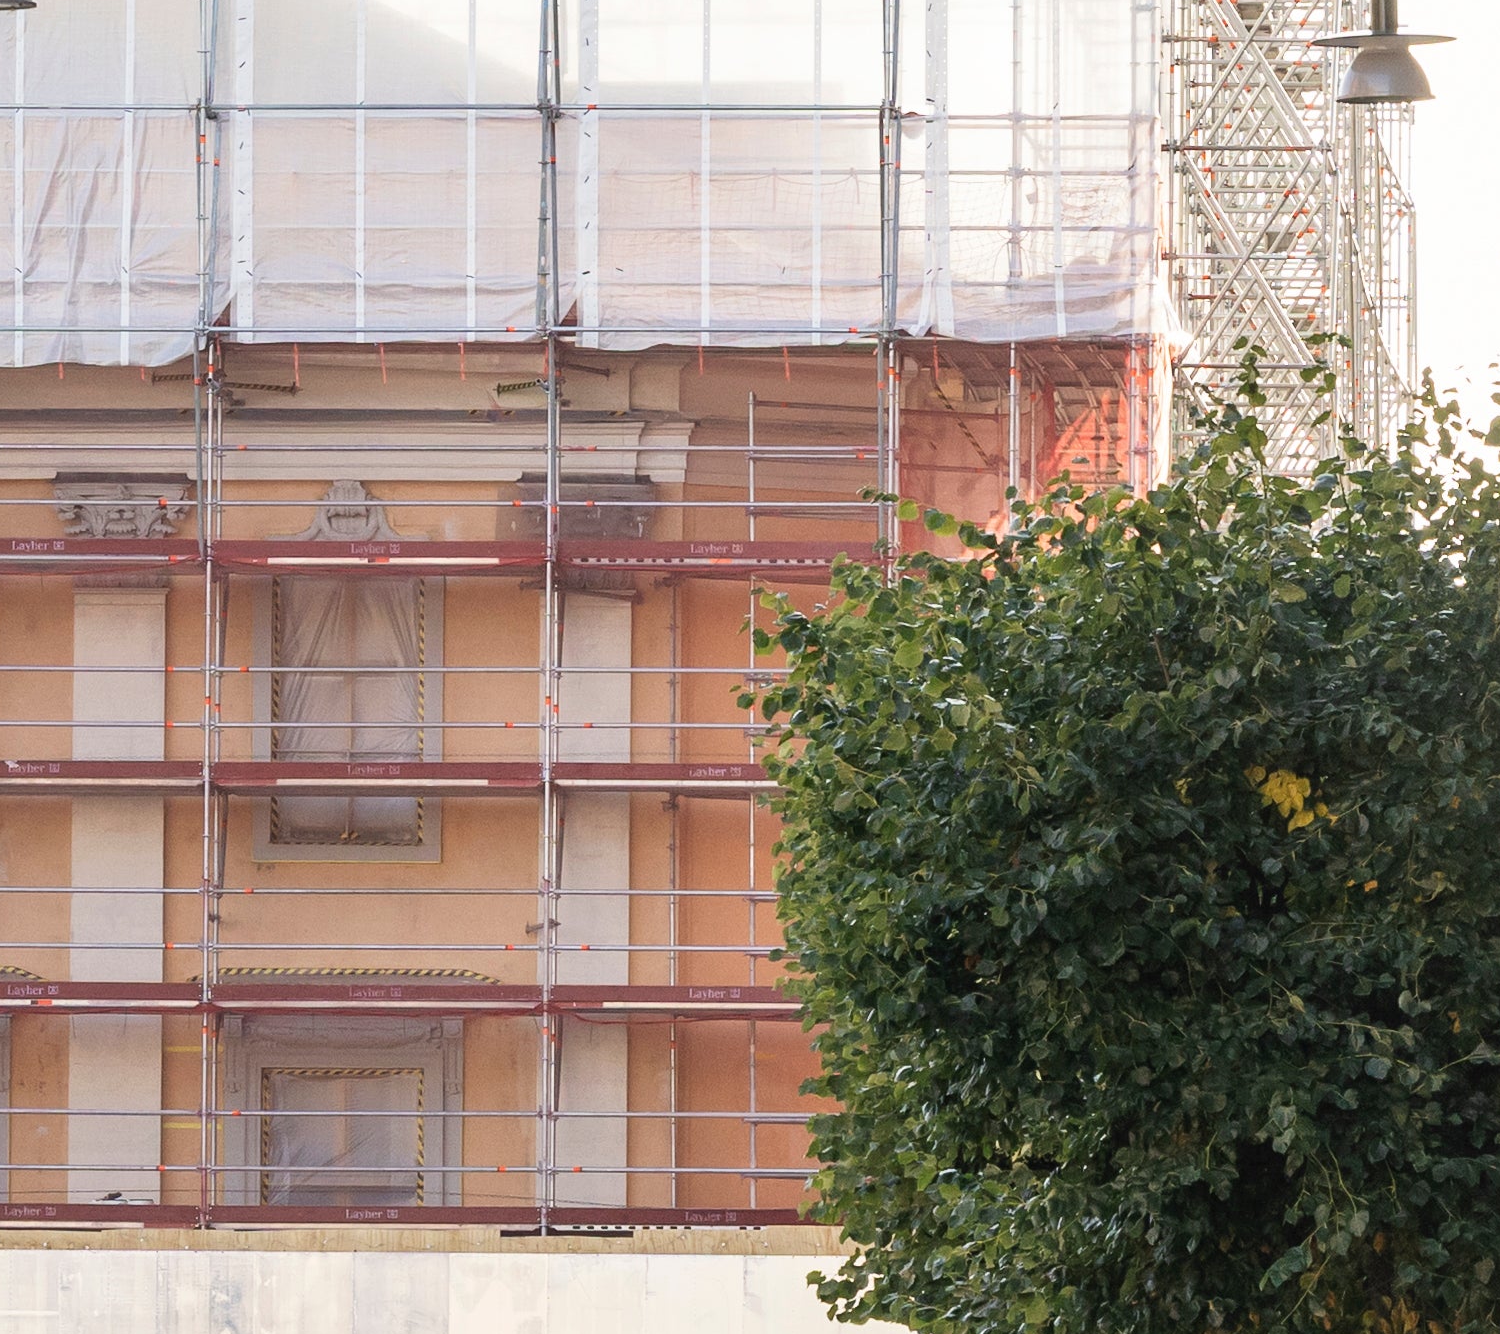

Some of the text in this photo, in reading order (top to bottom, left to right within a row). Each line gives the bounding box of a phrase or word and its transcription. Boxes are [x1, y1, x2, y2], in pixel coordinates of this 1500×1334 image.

[12, 540, 49, 552] Layher
[351, 543, 386, 554] Layher
[690, 543, 728, 555] Layher
[7, 984, 44, 996] Layher
[689, 988, 726, 1000] Layher
[345, 1209, 384, 1220] Layher
